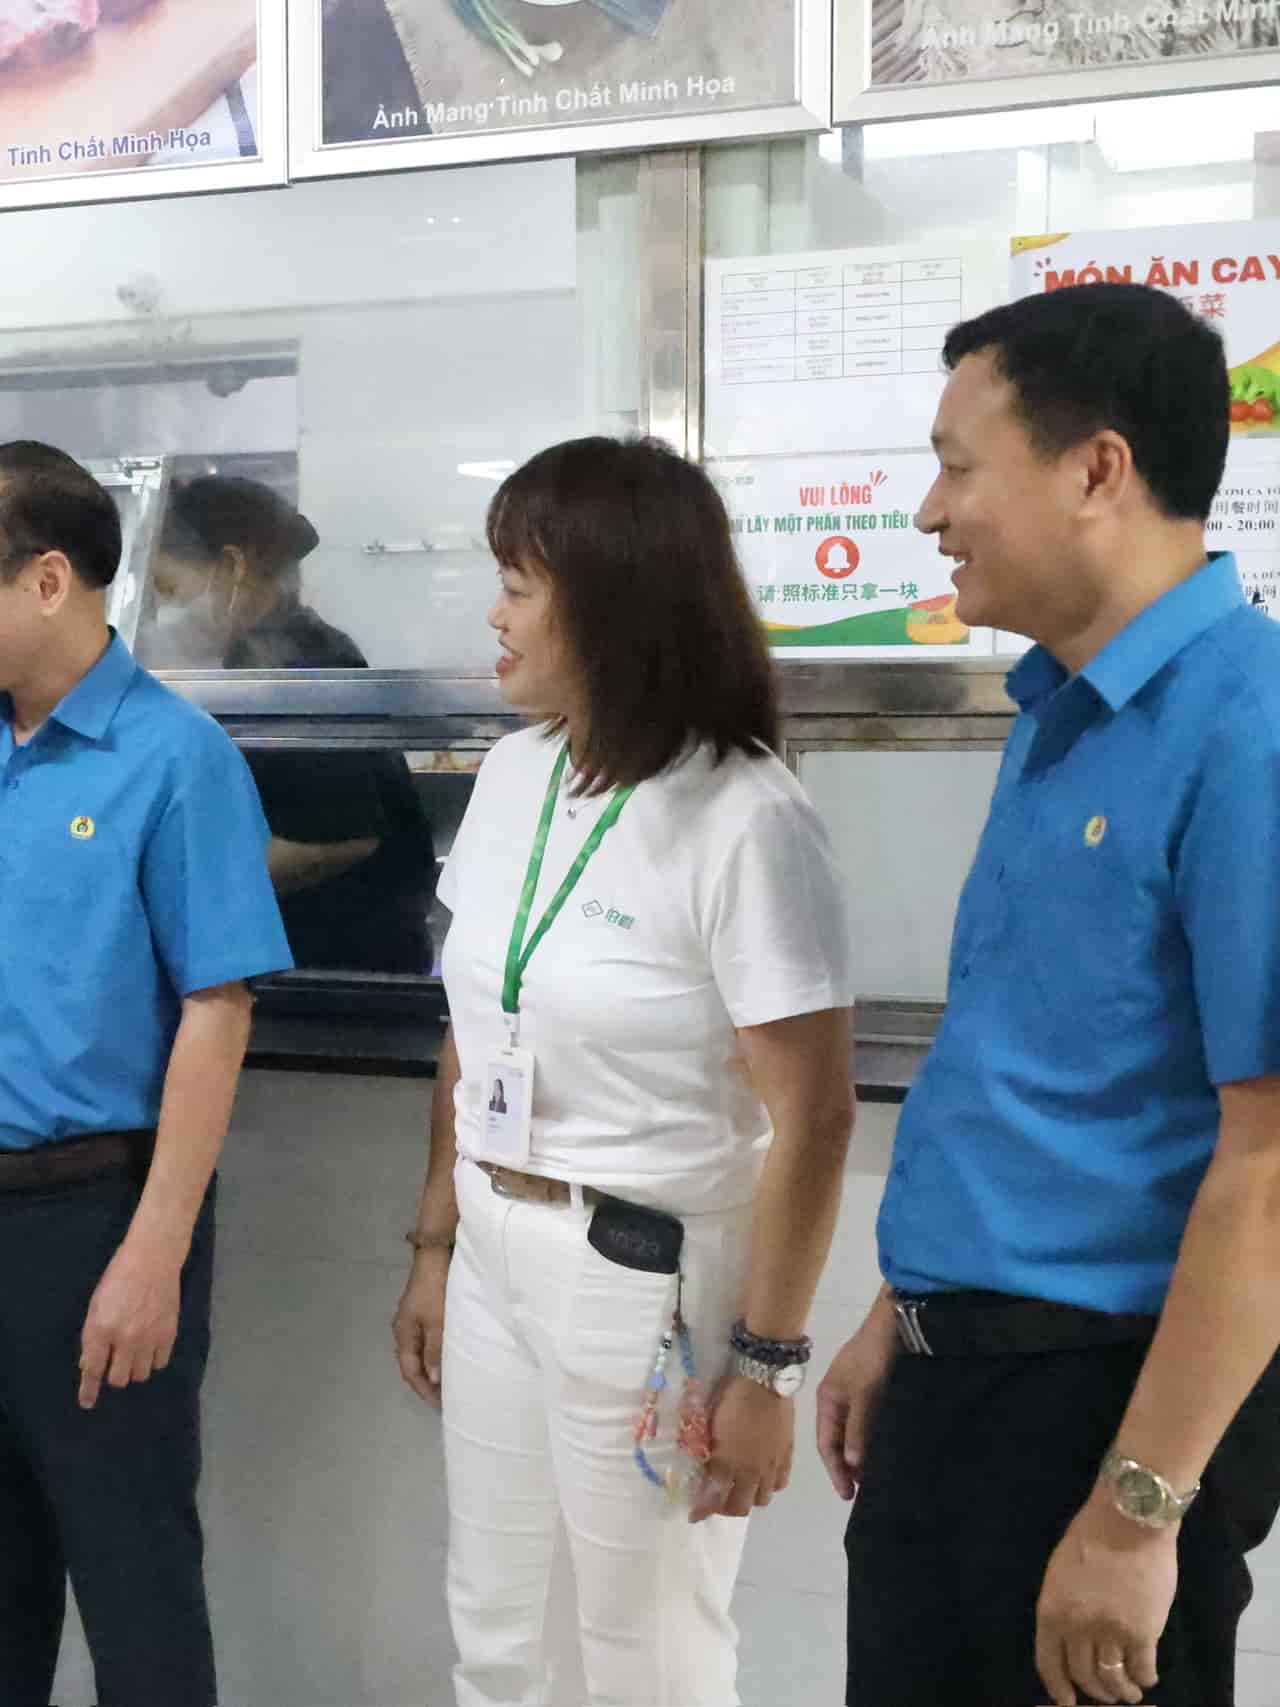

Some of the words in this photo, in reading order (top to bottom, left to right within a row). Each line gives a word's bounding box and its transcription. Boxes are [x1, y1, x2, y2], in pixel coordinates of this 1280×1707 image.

[426, 101, 489, 127] Mang
[620, 80, 679, 105] Minh
[686, 74, 736, 100] Họa
[58, 135, 106, 161] Chất
[112, 133, 163, 156] Minh
[169, 129, 211, 153] Họa
[1144, 255, 1200, 287] ĂN
[799, 485, 825, 507] VUI
[845, 514, 878, 530] THEO
[1236, 519, 1275, 531] 20:00
